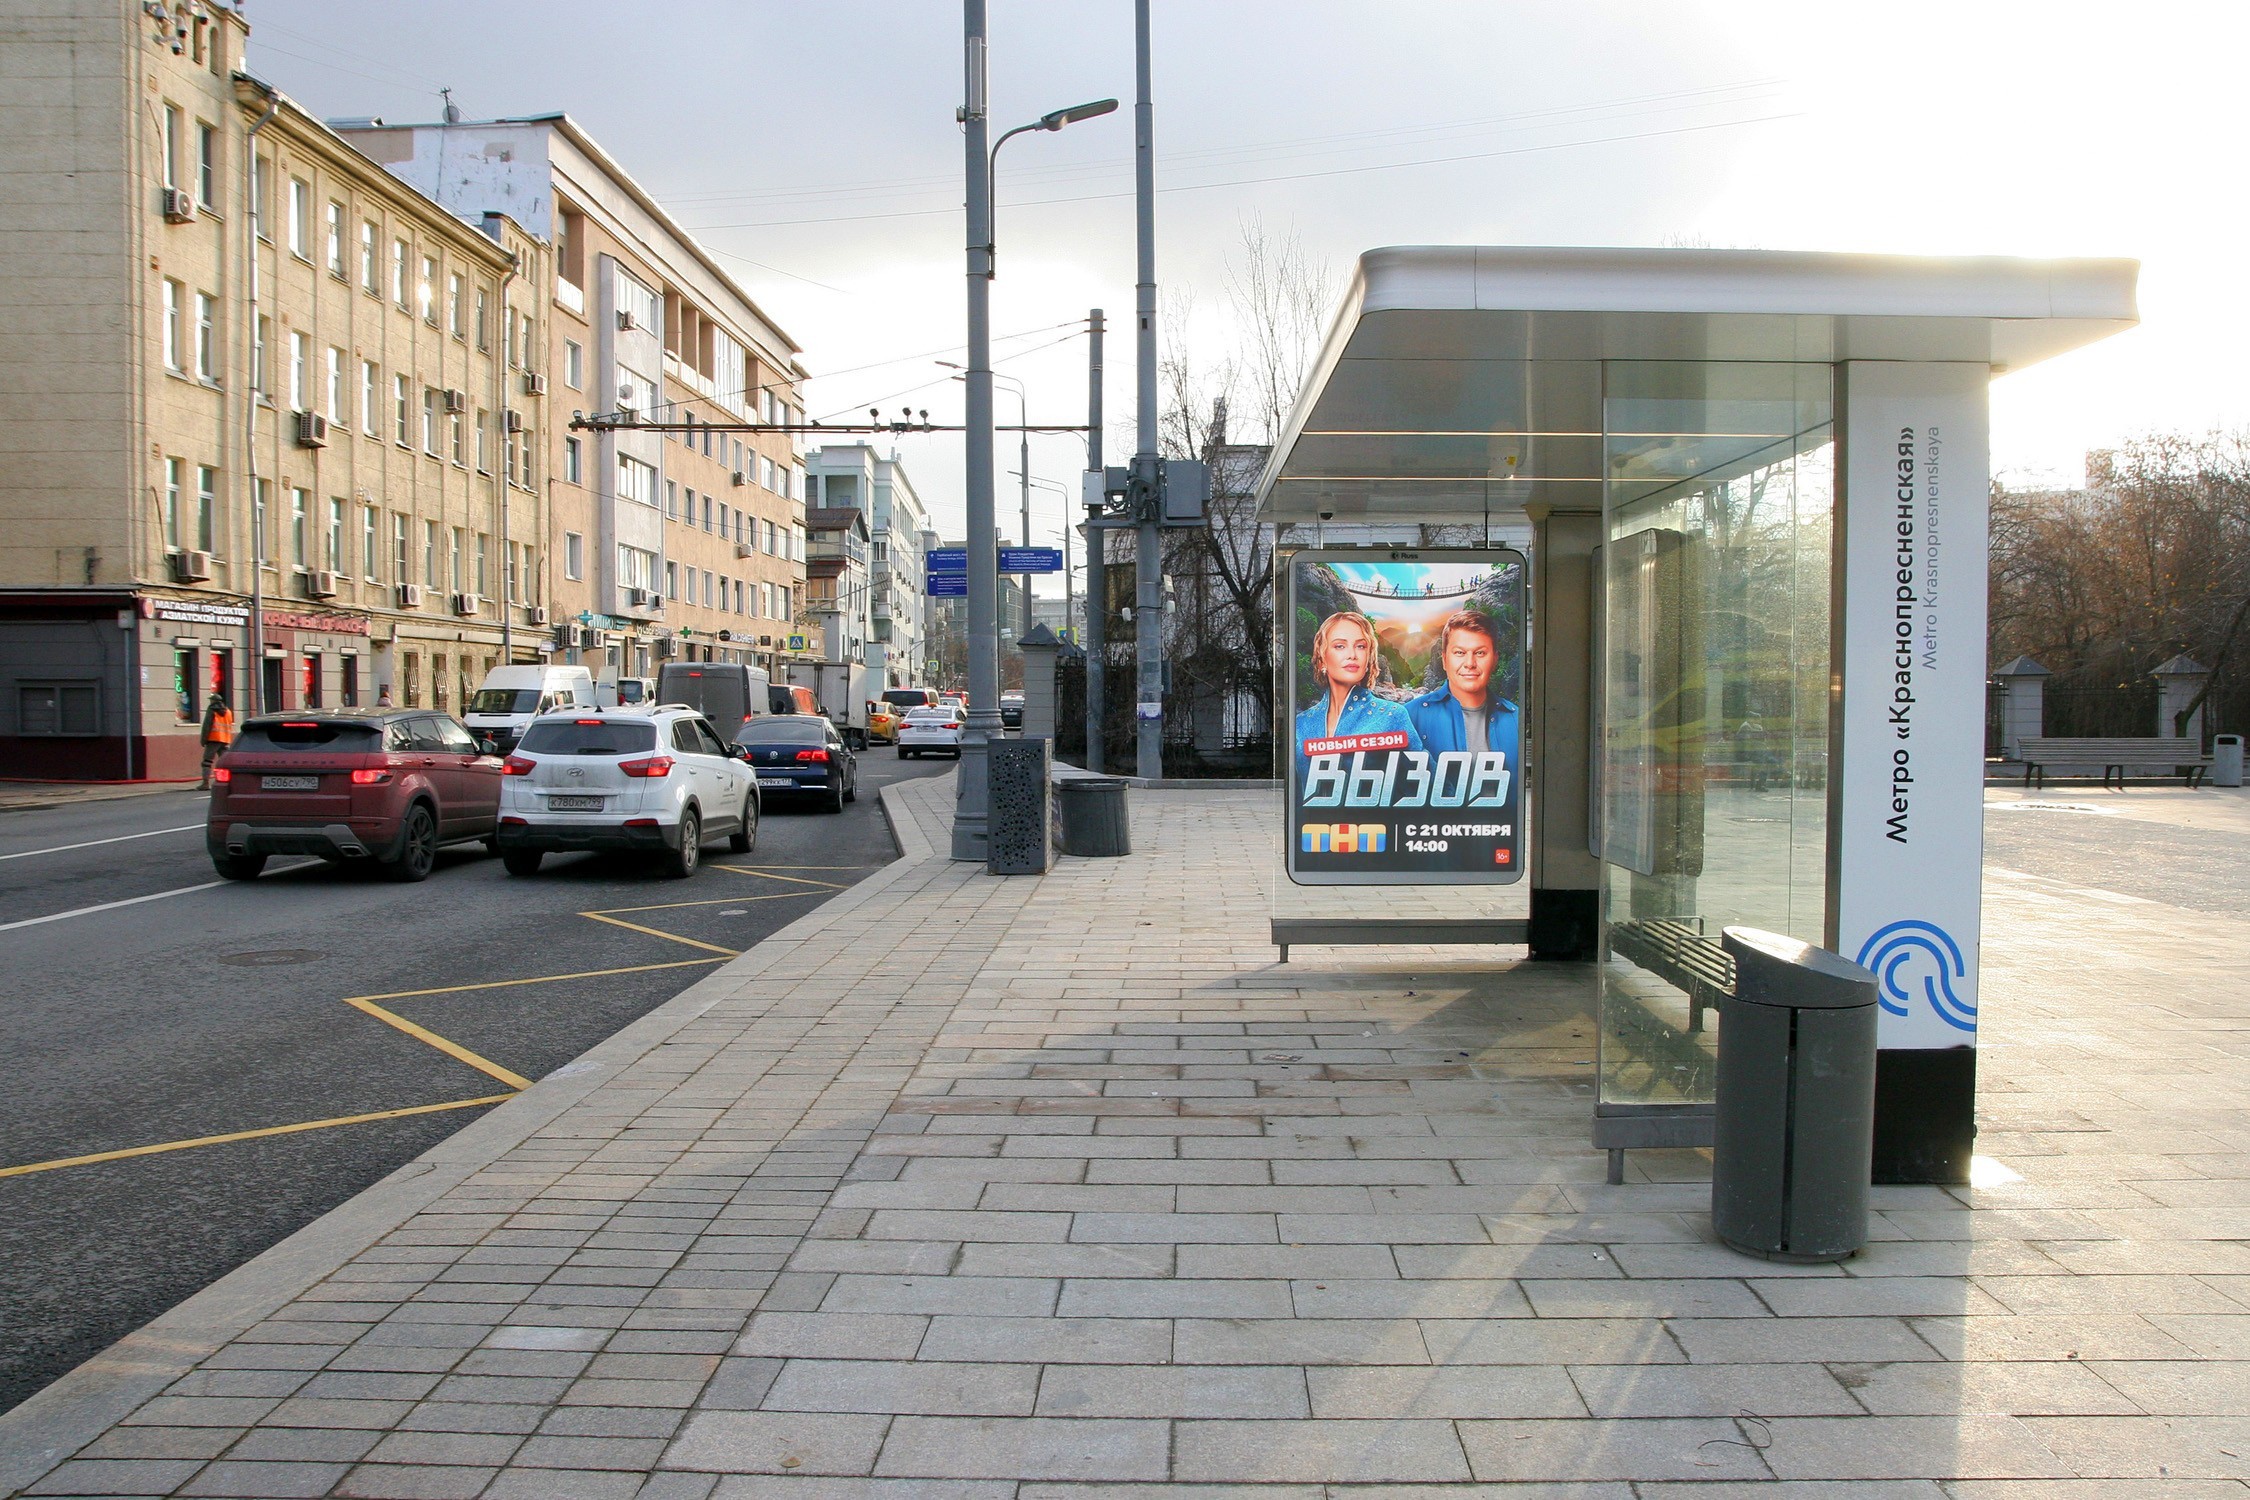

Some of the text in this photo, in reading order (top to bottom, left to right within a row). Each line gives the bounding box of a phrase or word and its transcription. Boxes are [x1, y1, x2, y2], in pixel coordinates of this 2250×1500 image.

[1922, 427, 1943, 670] Metro Krasnopresnenskaya
[155, 601, 249, 616] МАГАЗИН ПРОДУКТОВ
[161, 610, 244, 625] АЗИАТСКОЙ КУХНИ
[1886, 427, 1916, 844] Метро «Краснопресненская»
[1308, 734, 1403, 752] НОВЫЙ СЕЗОН
[1302, 751, 1511, 807] ВЫЗОВ
[1302, 823, 1387, 853] ТНТ
[1405, 824, 1511, 836] С 21 ОКТЯБРЯ
[1405, 840, 1448, 852] 14:00
[1496, 852, 1508, 860] 16+
